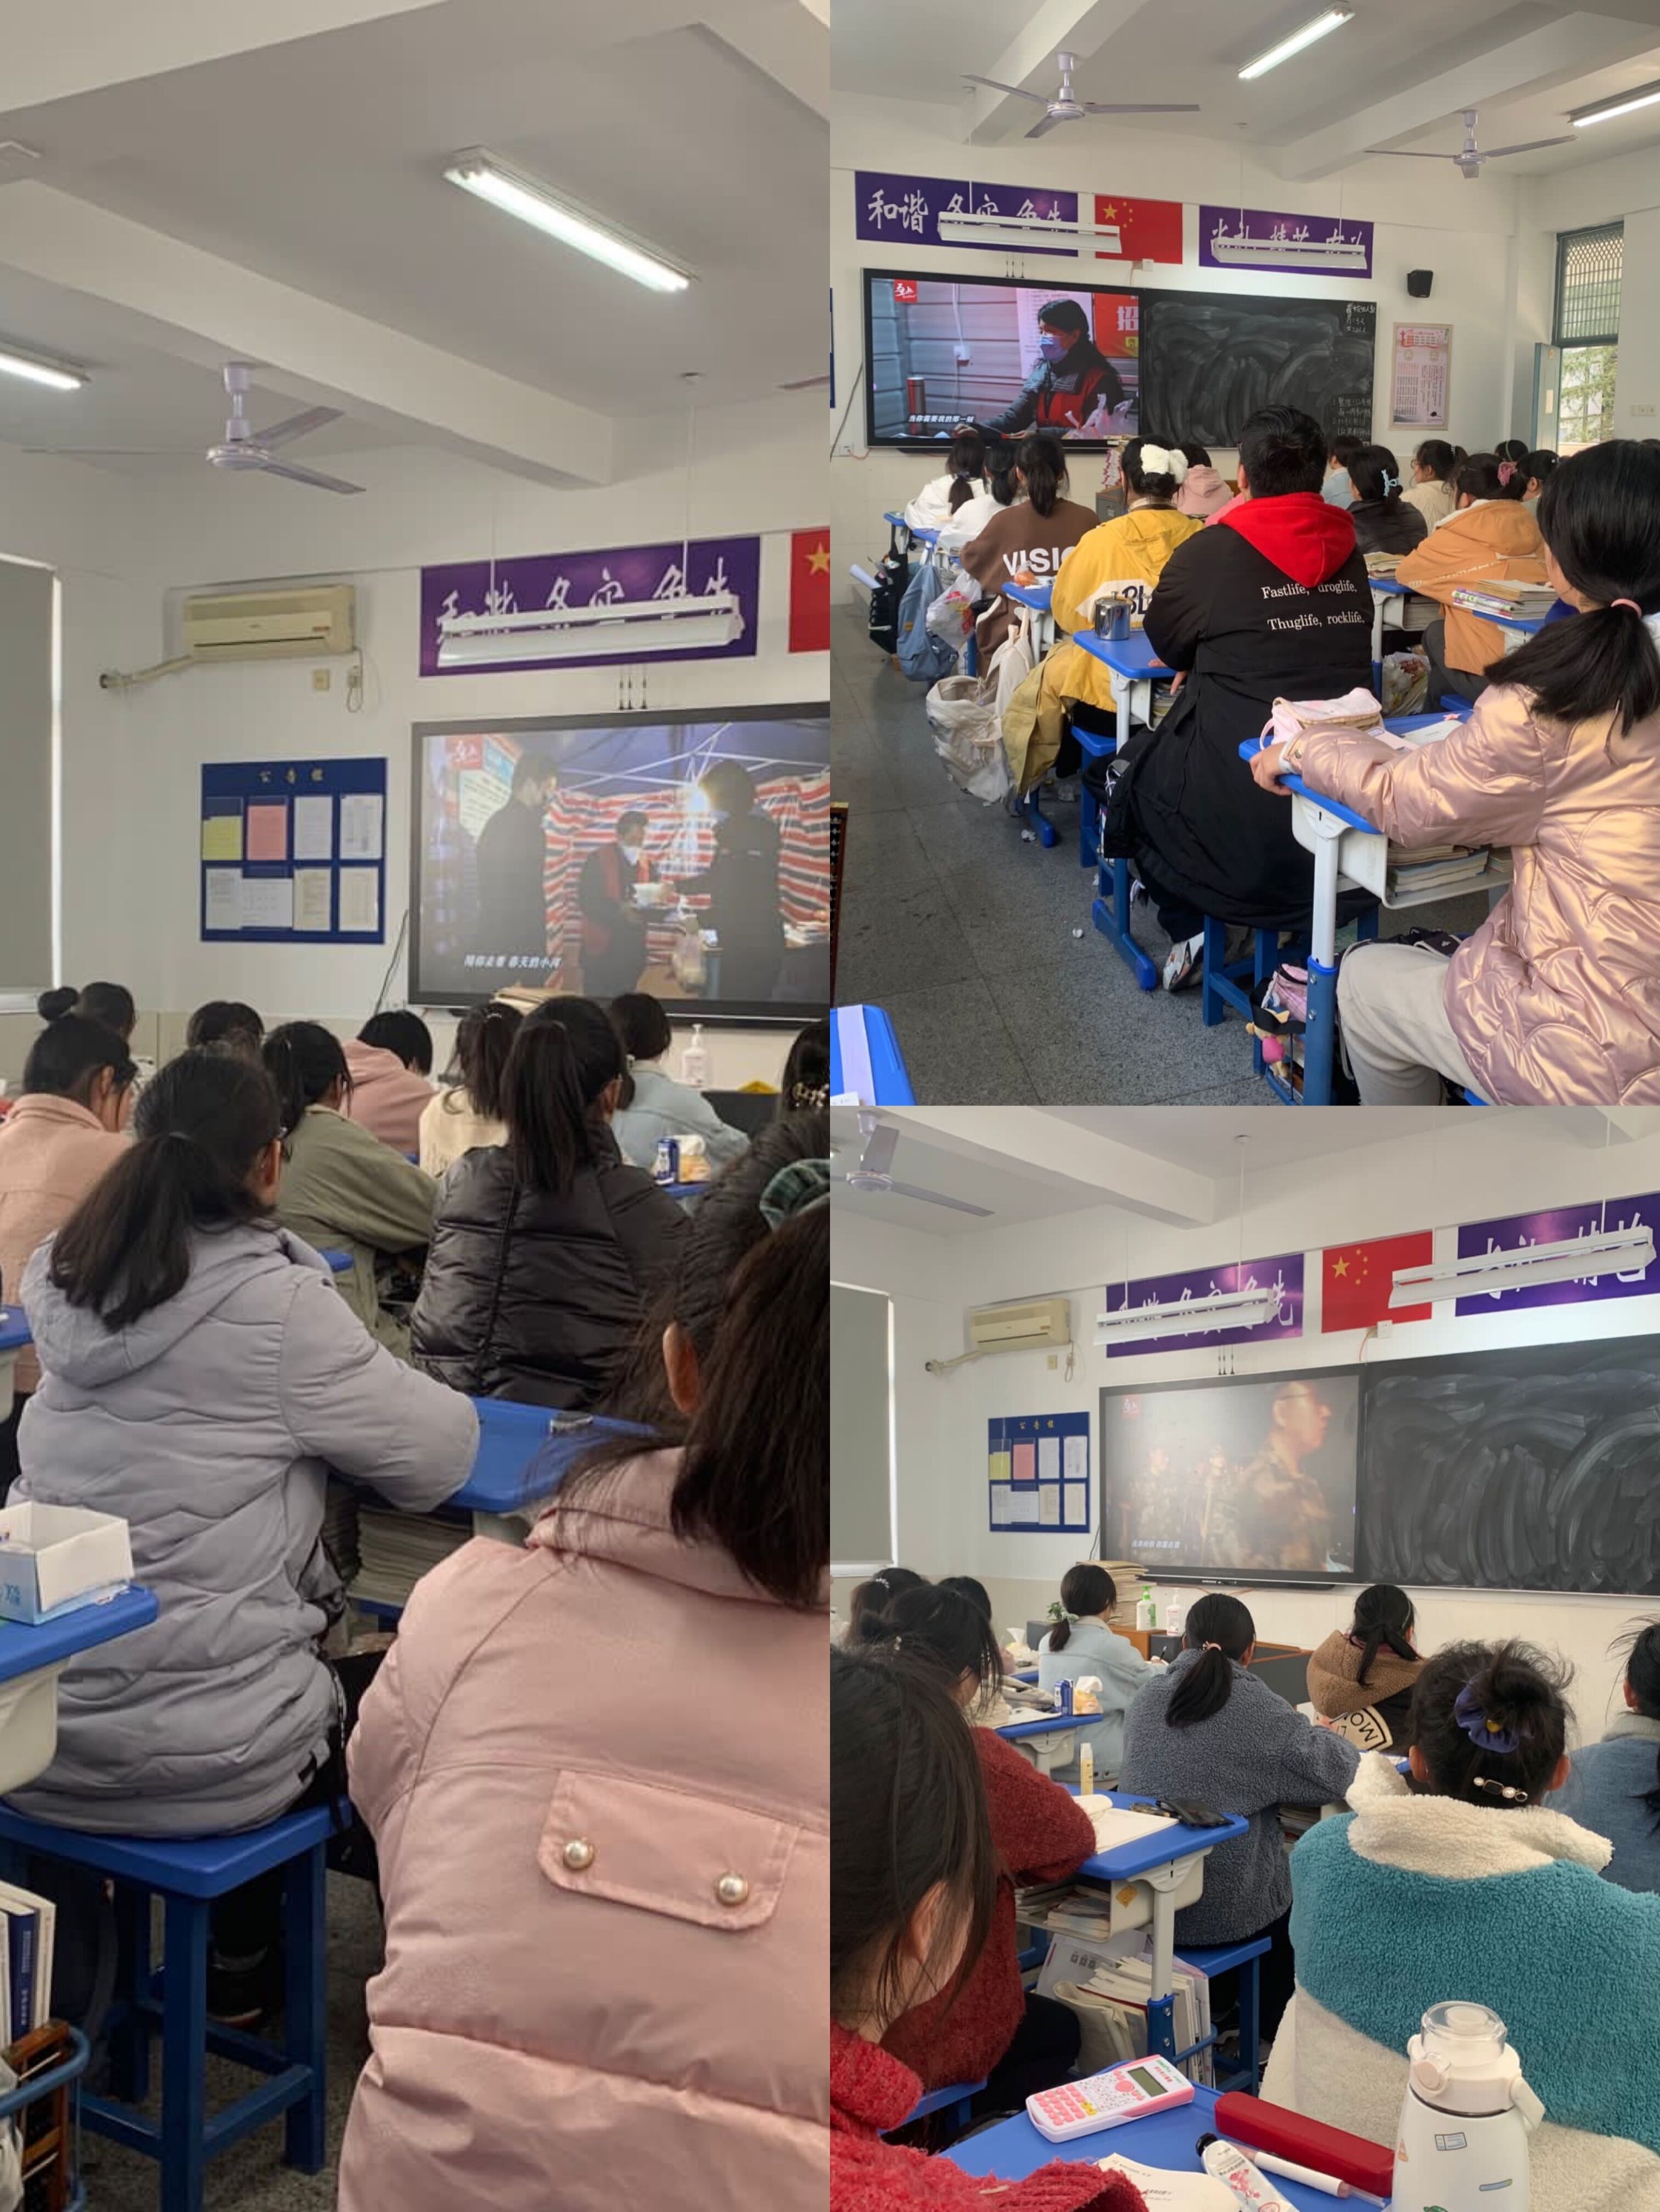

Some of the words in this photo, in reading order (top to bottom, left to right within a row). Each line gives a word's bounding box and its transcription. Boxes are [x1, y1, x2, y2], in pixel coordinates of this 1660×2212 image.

[868, 188, 929, 234] 和谐
[908, 414, 975, 423] 当你需要我的那一刻
[1260, 583, 1310, 599] Fastlife,
[1267, 614, 1322, 631] Thuglife,
